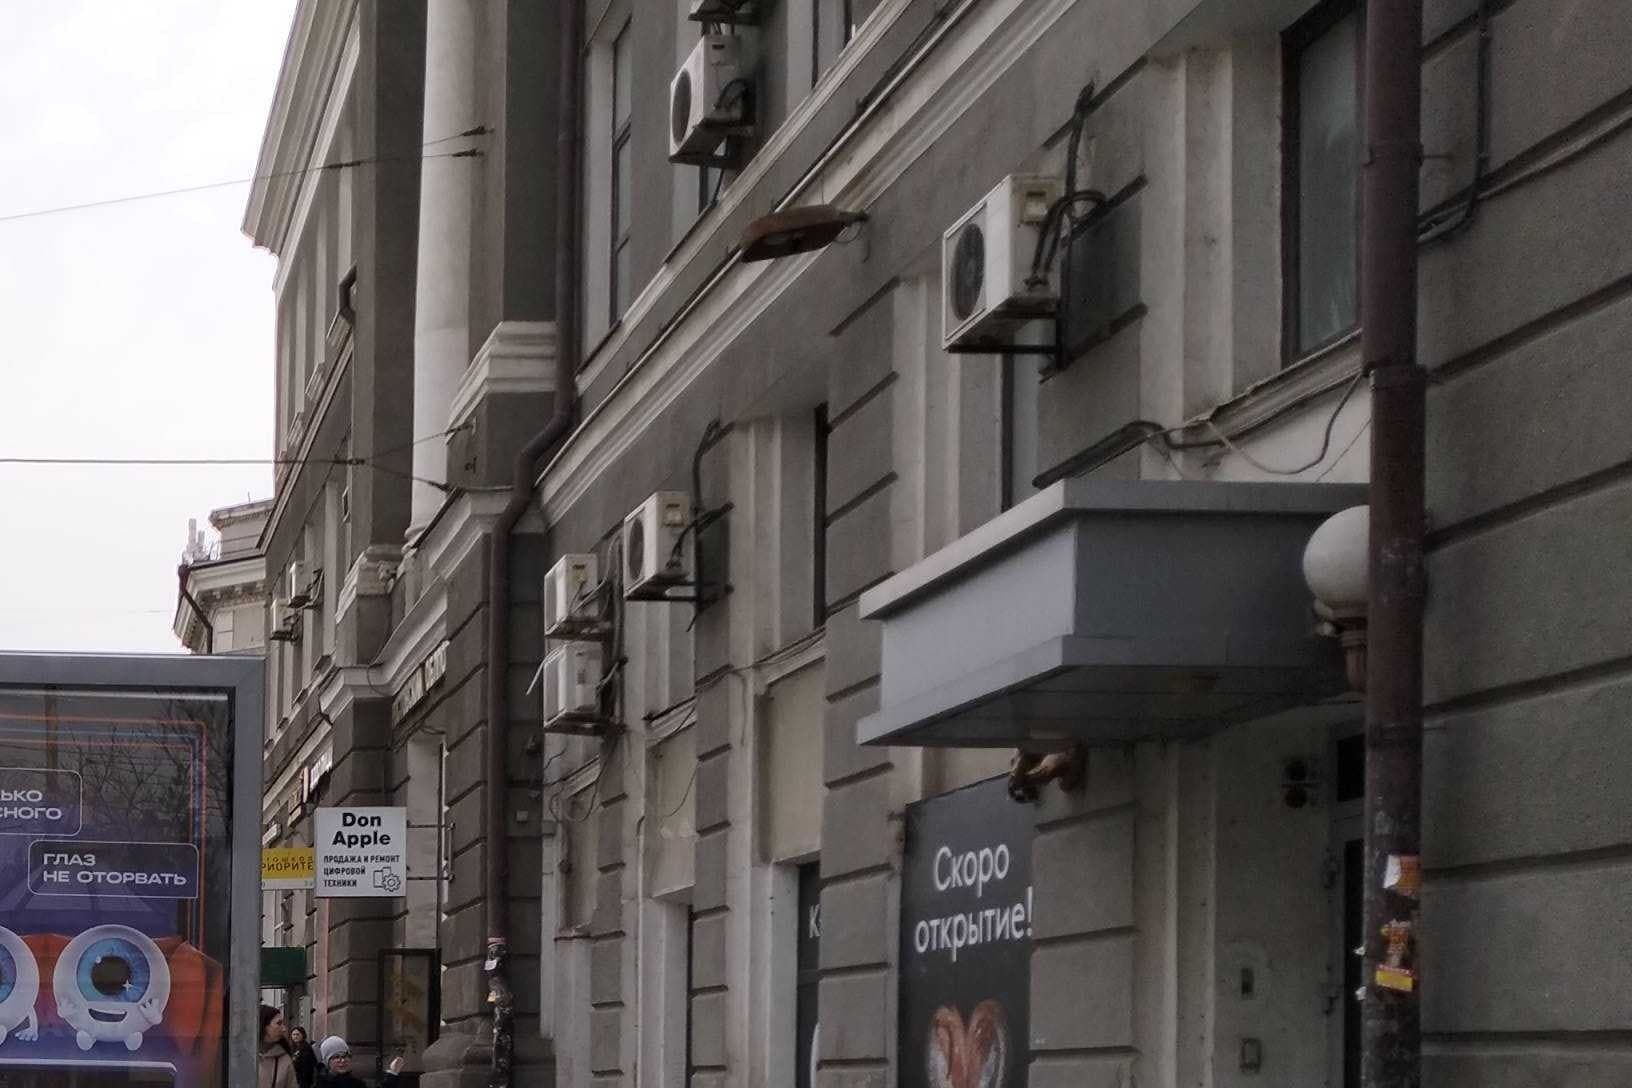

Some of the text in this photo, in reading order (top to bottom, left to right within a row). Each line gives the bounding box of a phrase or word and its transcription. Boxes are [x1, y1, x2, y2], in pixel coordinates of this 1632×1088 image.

[342, 812, 382, 827] Don
[332, 830, 392, 848] Apple
[43, 853, 97, 867] ГЛАЗ
[323, 855, 362, 864] ПРОДАЖА
[370, 855, 401, 864] РЕМОНТ
[43, 870, 187, 886] НЕ ОТОРВАТЬ
[323, 866, 366, 877] ЦИФРОВОЙ
[933, 843, 1011, 899] Скоро
[323, 879, 358, 888] ТЕХНИКИ
[914, 885, 1034, 962] открытие!
